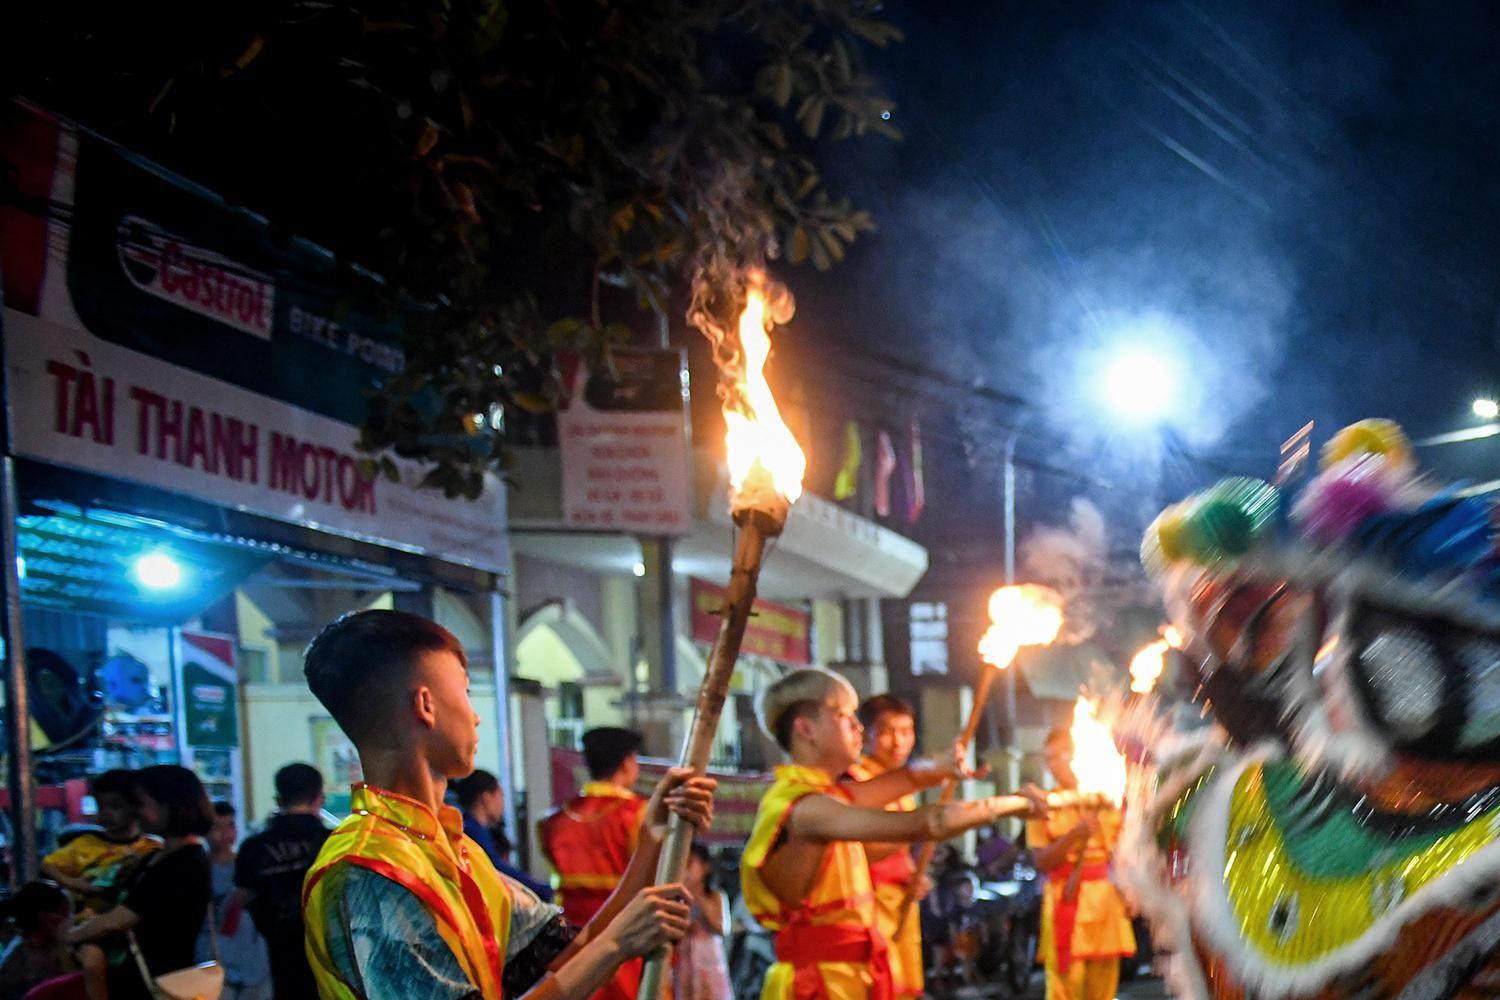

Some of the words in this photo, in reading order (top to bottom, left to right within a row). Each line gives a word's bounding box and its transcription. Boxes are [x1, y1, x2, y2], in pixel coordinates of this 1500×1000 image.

[159, 241, 267, 330] Castrol
[46, 350, 114, 446] TÀI
[130, 385, 258, 484] THANH
[268, 432, 376, 514] MOTOR
